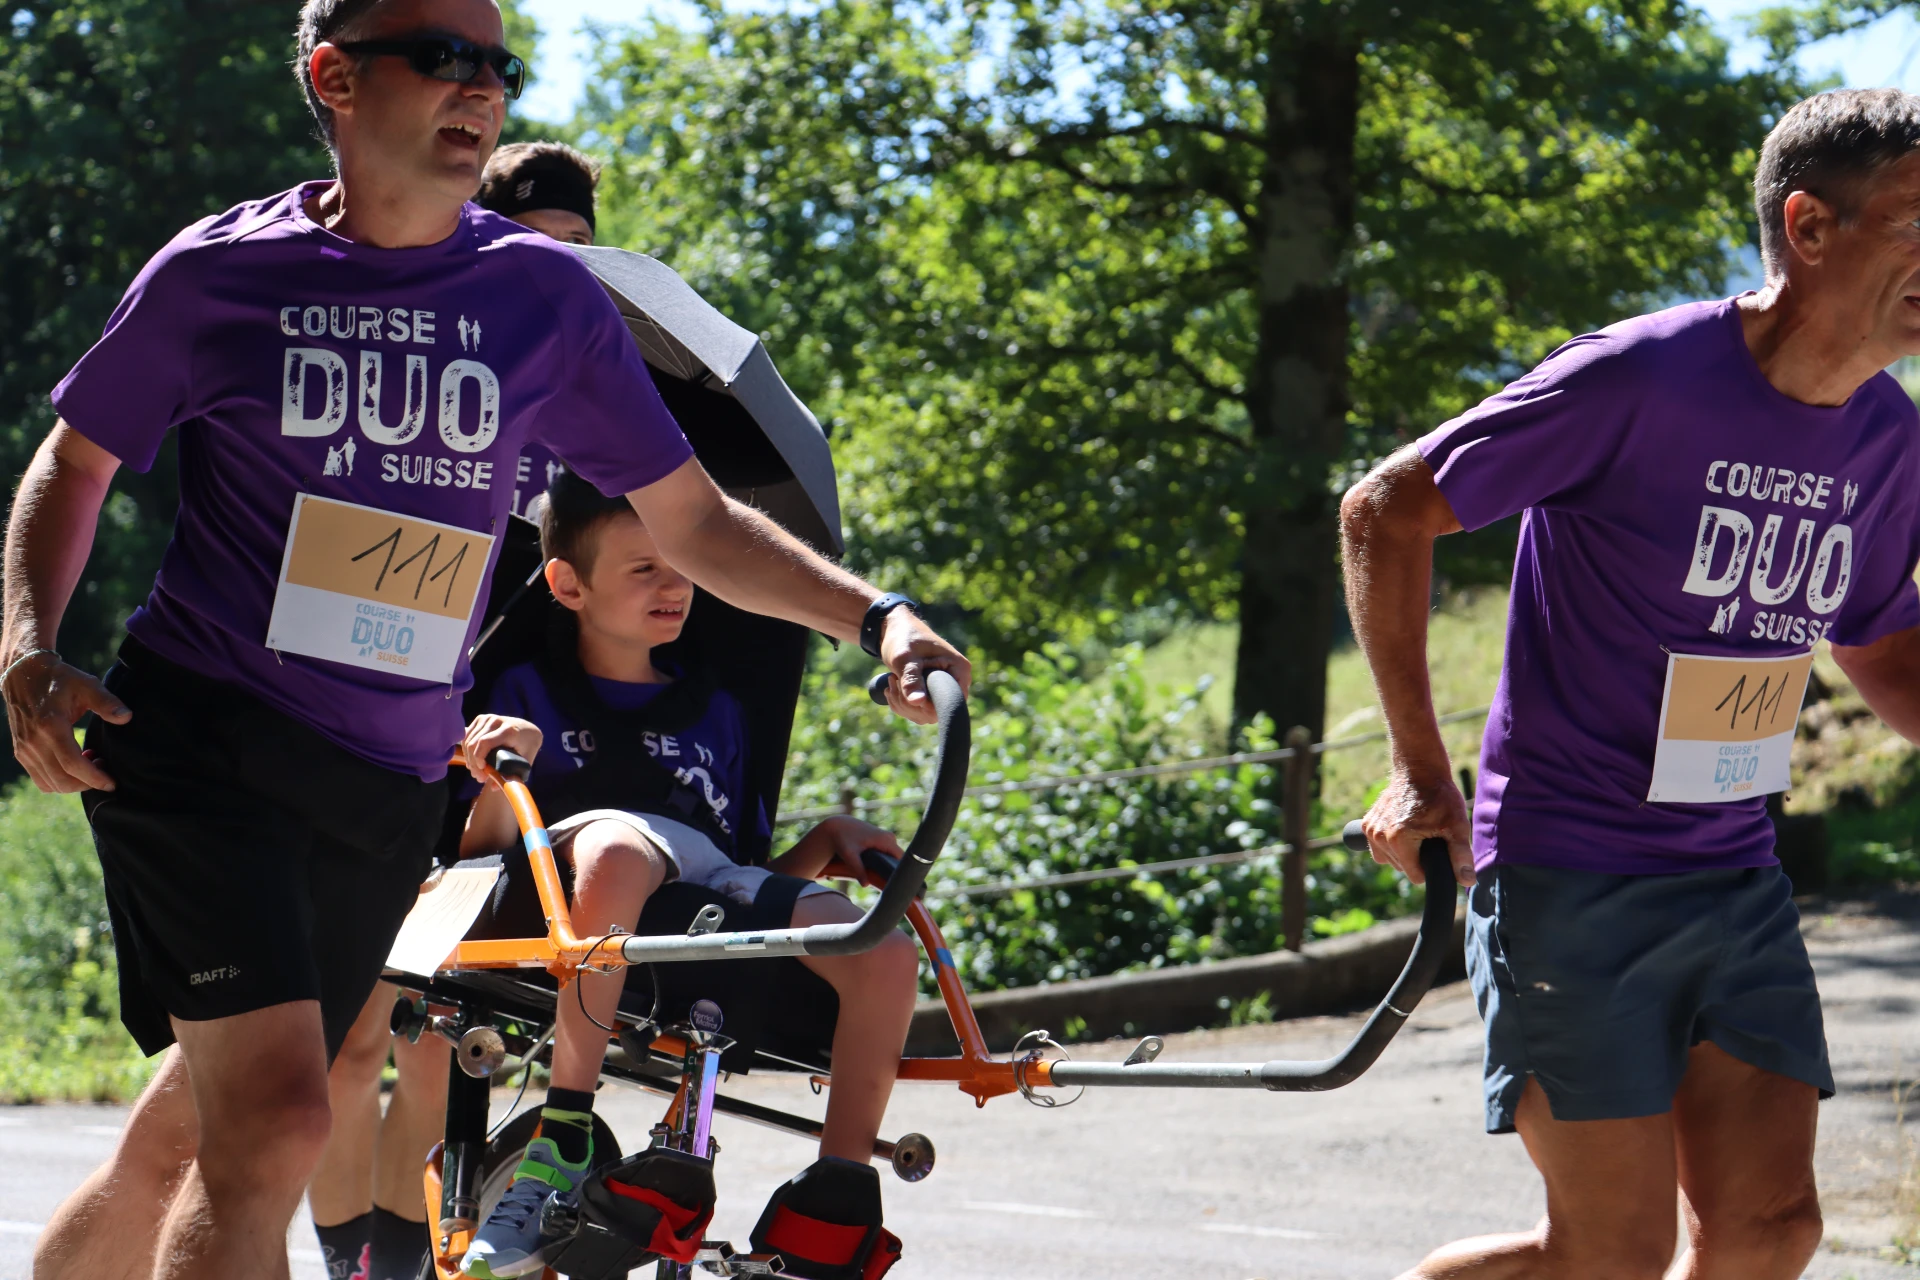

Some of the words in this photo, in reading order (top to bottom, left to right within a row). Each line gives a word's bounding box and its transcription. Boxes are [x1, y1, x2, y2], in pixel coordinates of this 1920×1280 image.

[280, 305, 436, 344] COURSE
[281, 347, 500, 453] DUO
[380, 453, 494, 490] SUISSE
[1705, 460, 1835, 510] COURSE
[351, 526, 469, 608] 111
[1681, 504, 1853, 615] DUO
[355, 602, 402, 622] COURSE
[350, 616, 415, 655] DUO
[376, 651, 409, 666] SUISSE
[1715, 671, 1789, 731] 111
[561, 729, 680, 757] COSE
[1718, 744, 1752, 756] COURSE
[1714, 755, 1759, 783] DUO
[190, 967, 227, 985] CRAFT
